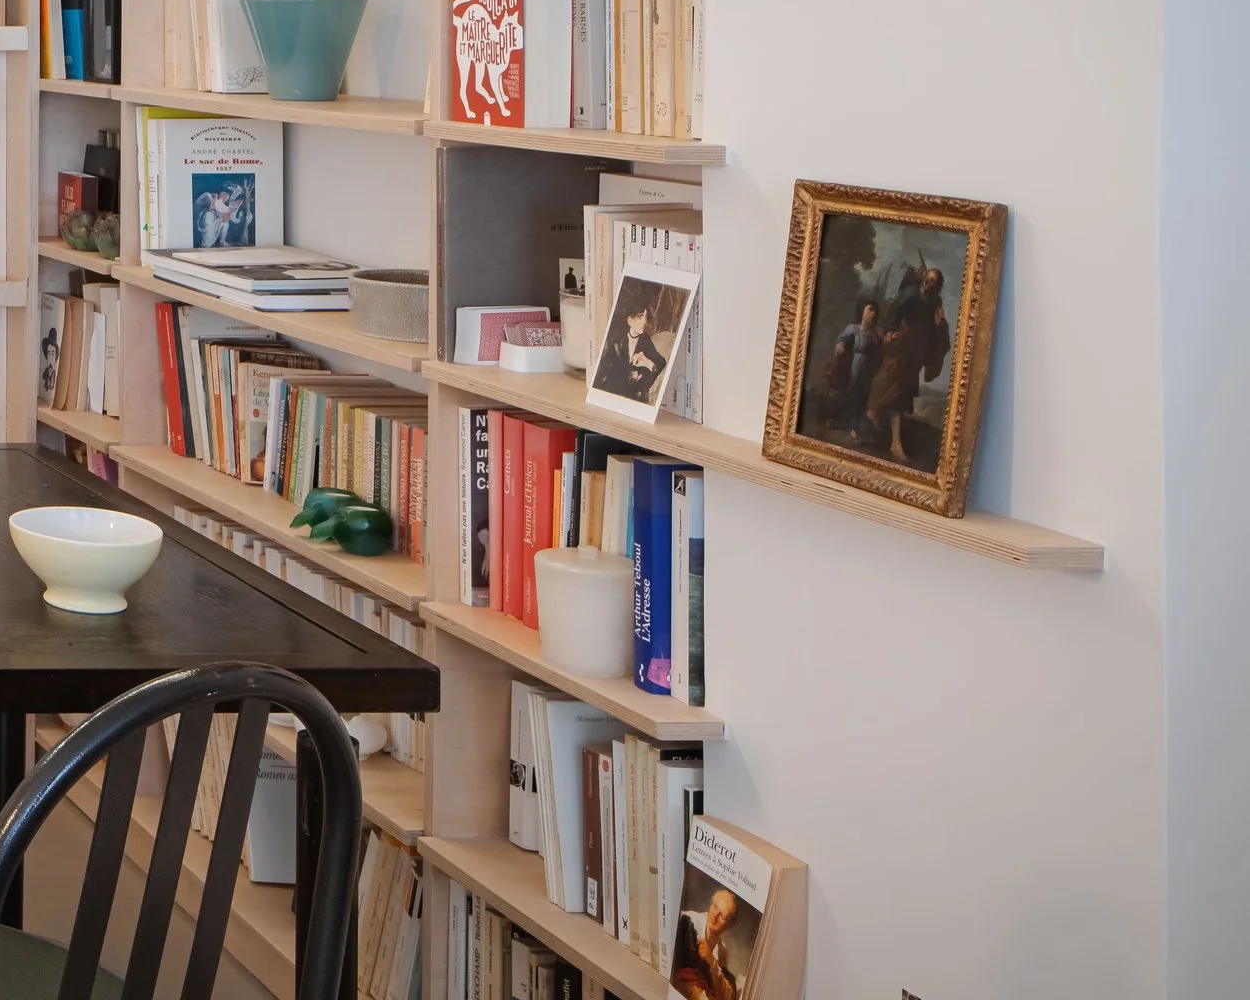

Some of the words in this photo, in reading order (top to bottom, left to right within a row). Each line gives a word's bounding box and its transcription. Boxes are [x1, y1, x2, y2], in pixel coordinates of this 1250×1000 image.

[462, 16, 491, 42] MAÎTRE
[468, 10, 476, 22] LE
[579, 2, 587, 43] BARNES
[459, 42, 466, 55] ET
[467, 22, 517, 65] MARGUERITE
[190, 125, 230, 141] Bibliothèque
[232, 158, 264, 166] Rome,
[525, 460, 534, 503] d'Helen
[523, 505, 534, 548] Journal
[634, 542, 643, 588] Teboul
[634, 590, 642, 638] Arthur
[641, 578, 652, 644] L'Adresse
[694, 824, 737, 864] Diderot
[691, 842, 712, 861] Lettres
[716, 859, 737, 876] Sophie
[737, 871, 758, 892] Volland
[473, 948, 481, 1000] DUCHAMP
